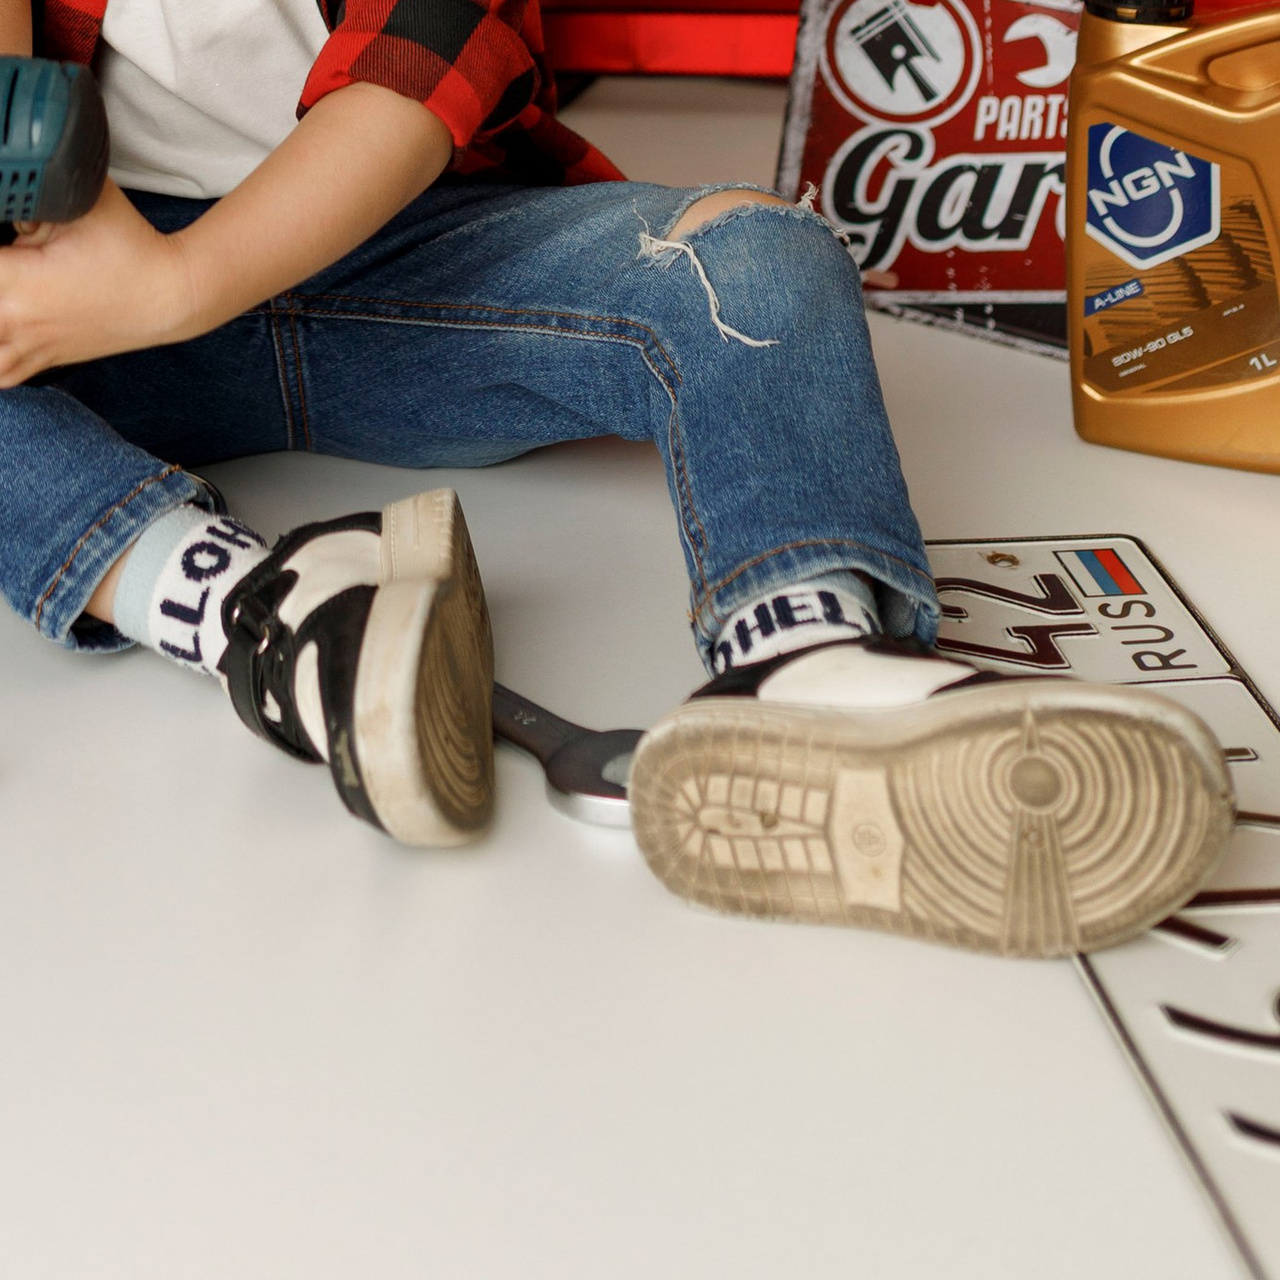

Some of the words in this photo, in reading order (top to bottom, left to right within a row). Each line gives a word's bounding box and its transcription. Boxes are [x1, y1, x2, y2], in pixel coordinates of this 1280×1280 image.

[828, 126, 1067, 271] Gar
[1088, 151, 1197, 217] NGN
[1093, 281, 1141, 311] A-LINE
[1249, 352, 1278, 372] 1L
[933, 573, 1098, 670] 42
[1097, 599, 1198, 672] RUS
